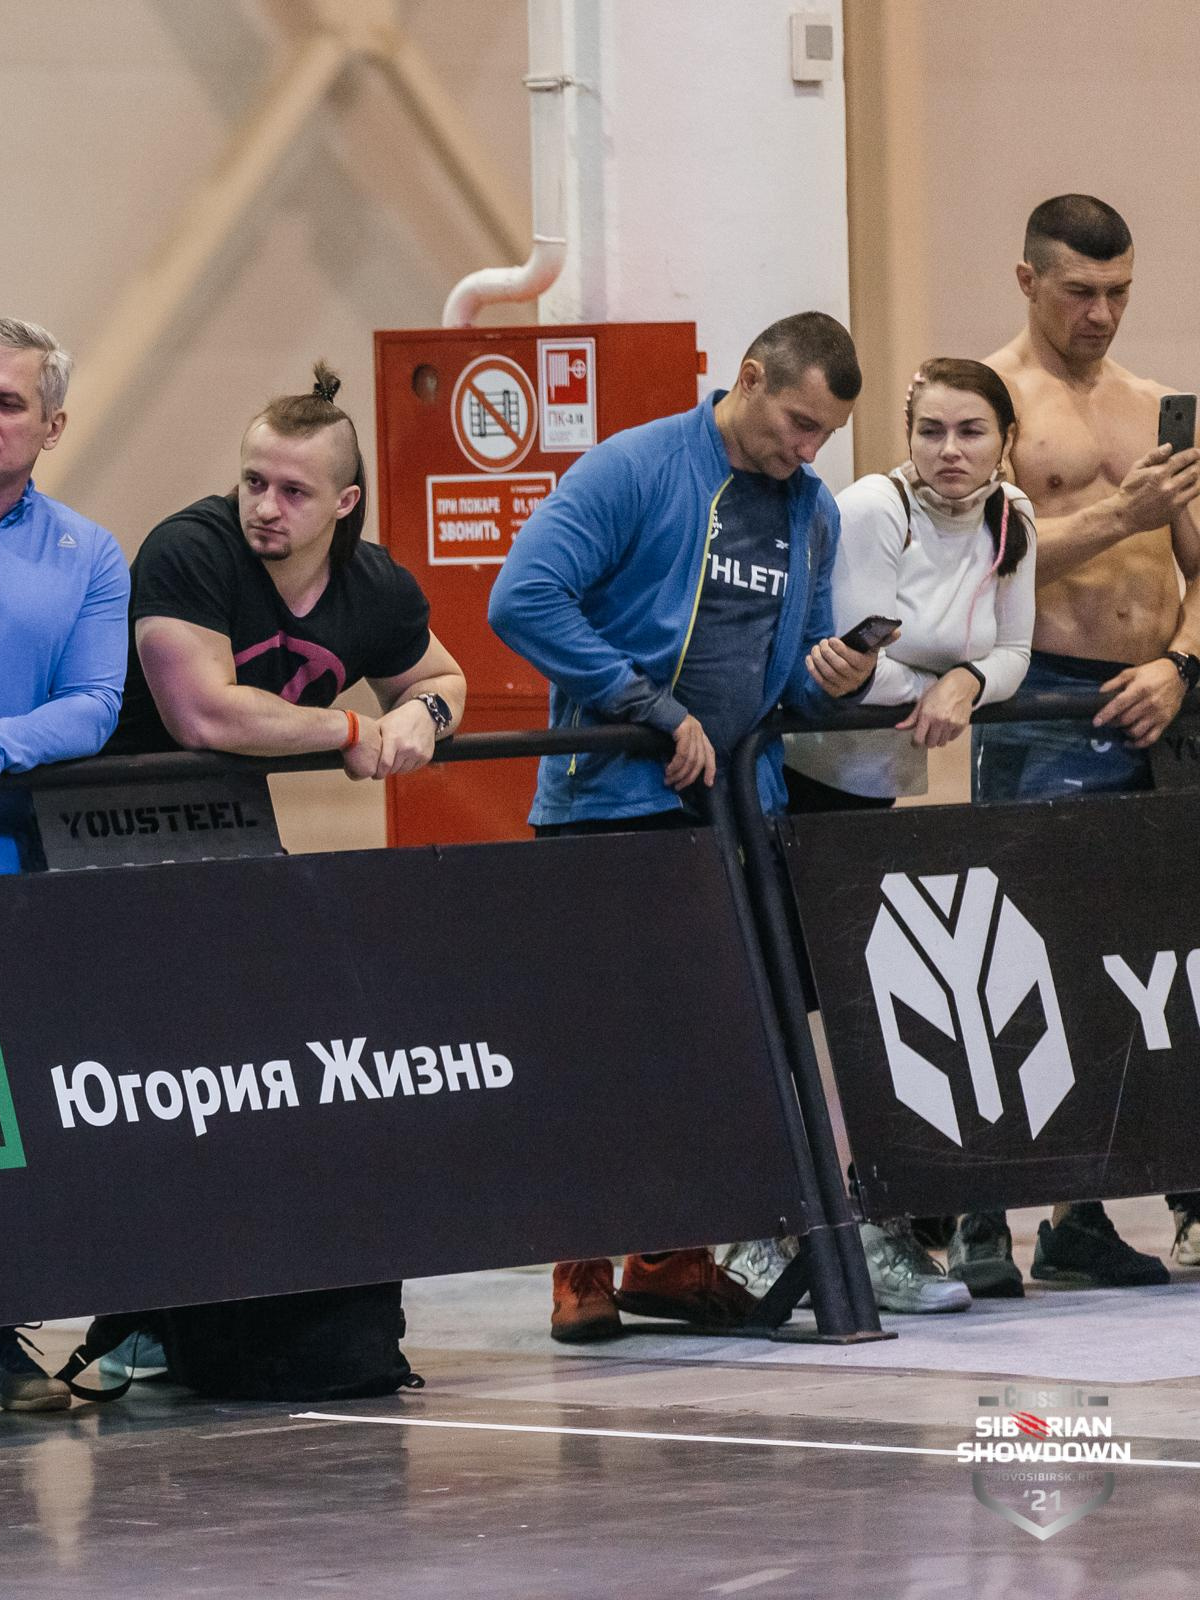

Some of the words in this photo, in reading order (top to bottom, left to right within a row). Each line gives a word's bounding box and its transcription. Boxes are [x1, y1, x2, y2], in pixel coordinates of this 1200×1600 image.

[437, 498, 458, 514] ПРИ
[459, 496, 500, 514] ПОЖАРЕ
[439, 520, 501, 541] ЗВОНИТЬ
[707, 553, 788, 597] HLET
[59, 801, 257, 838] YOUSTEEL
[1102, 948, 1200, 1050] Y
[50, 1060, 300, 1137] Югория
[305, 1037, 514, 1104] Жизнь
